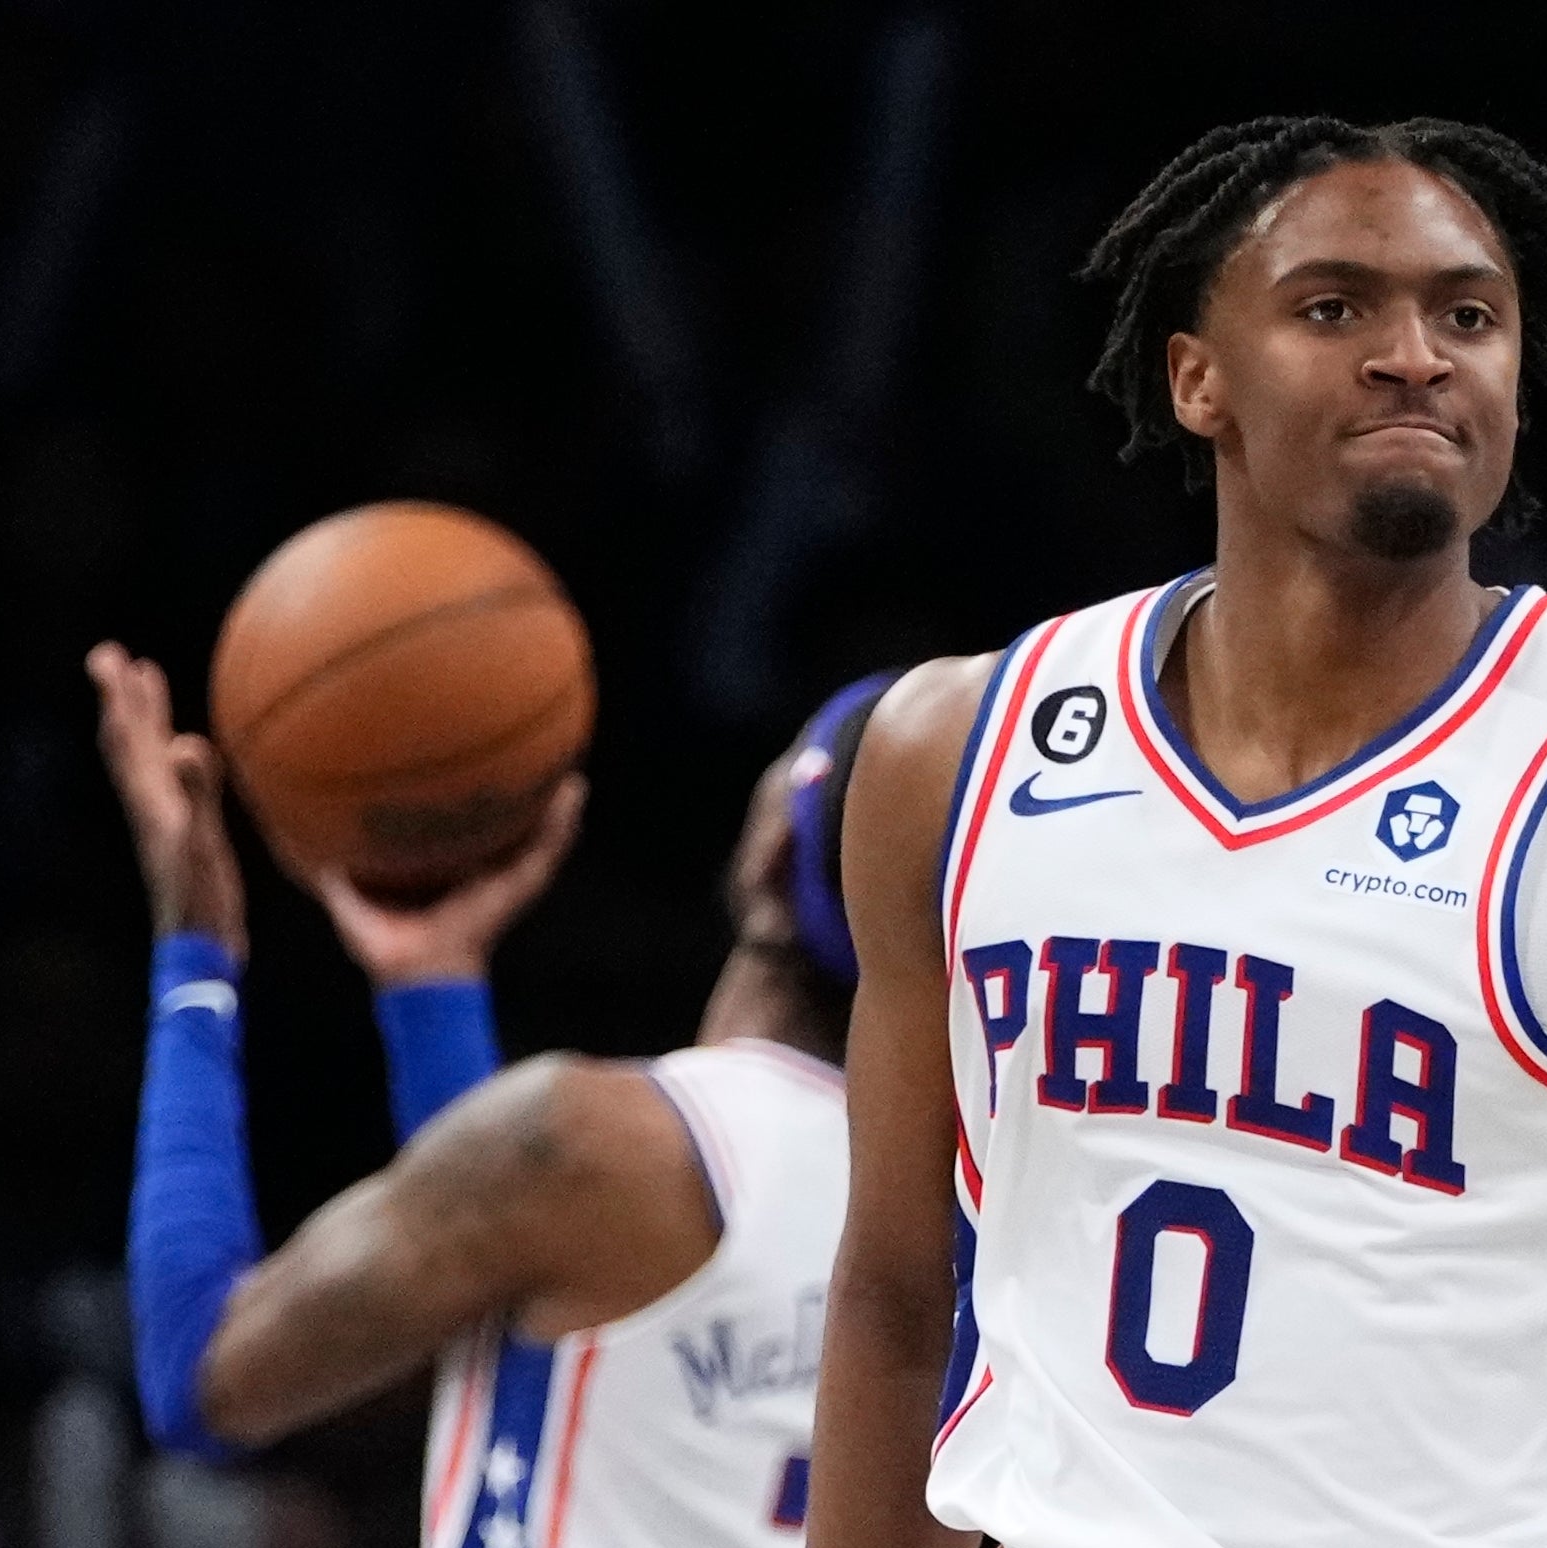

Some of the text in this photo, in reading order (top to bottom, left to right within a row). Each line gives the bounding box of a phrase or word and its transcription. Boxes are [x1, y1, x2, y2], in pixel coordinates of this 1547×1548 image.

[1045, 695, 1099, 755] 6
[1324, 868, 1469, 908] crypto.com
[961, 935, 1466, 1197] PHILA
[1104, 1177, 1255, 1417] 0
